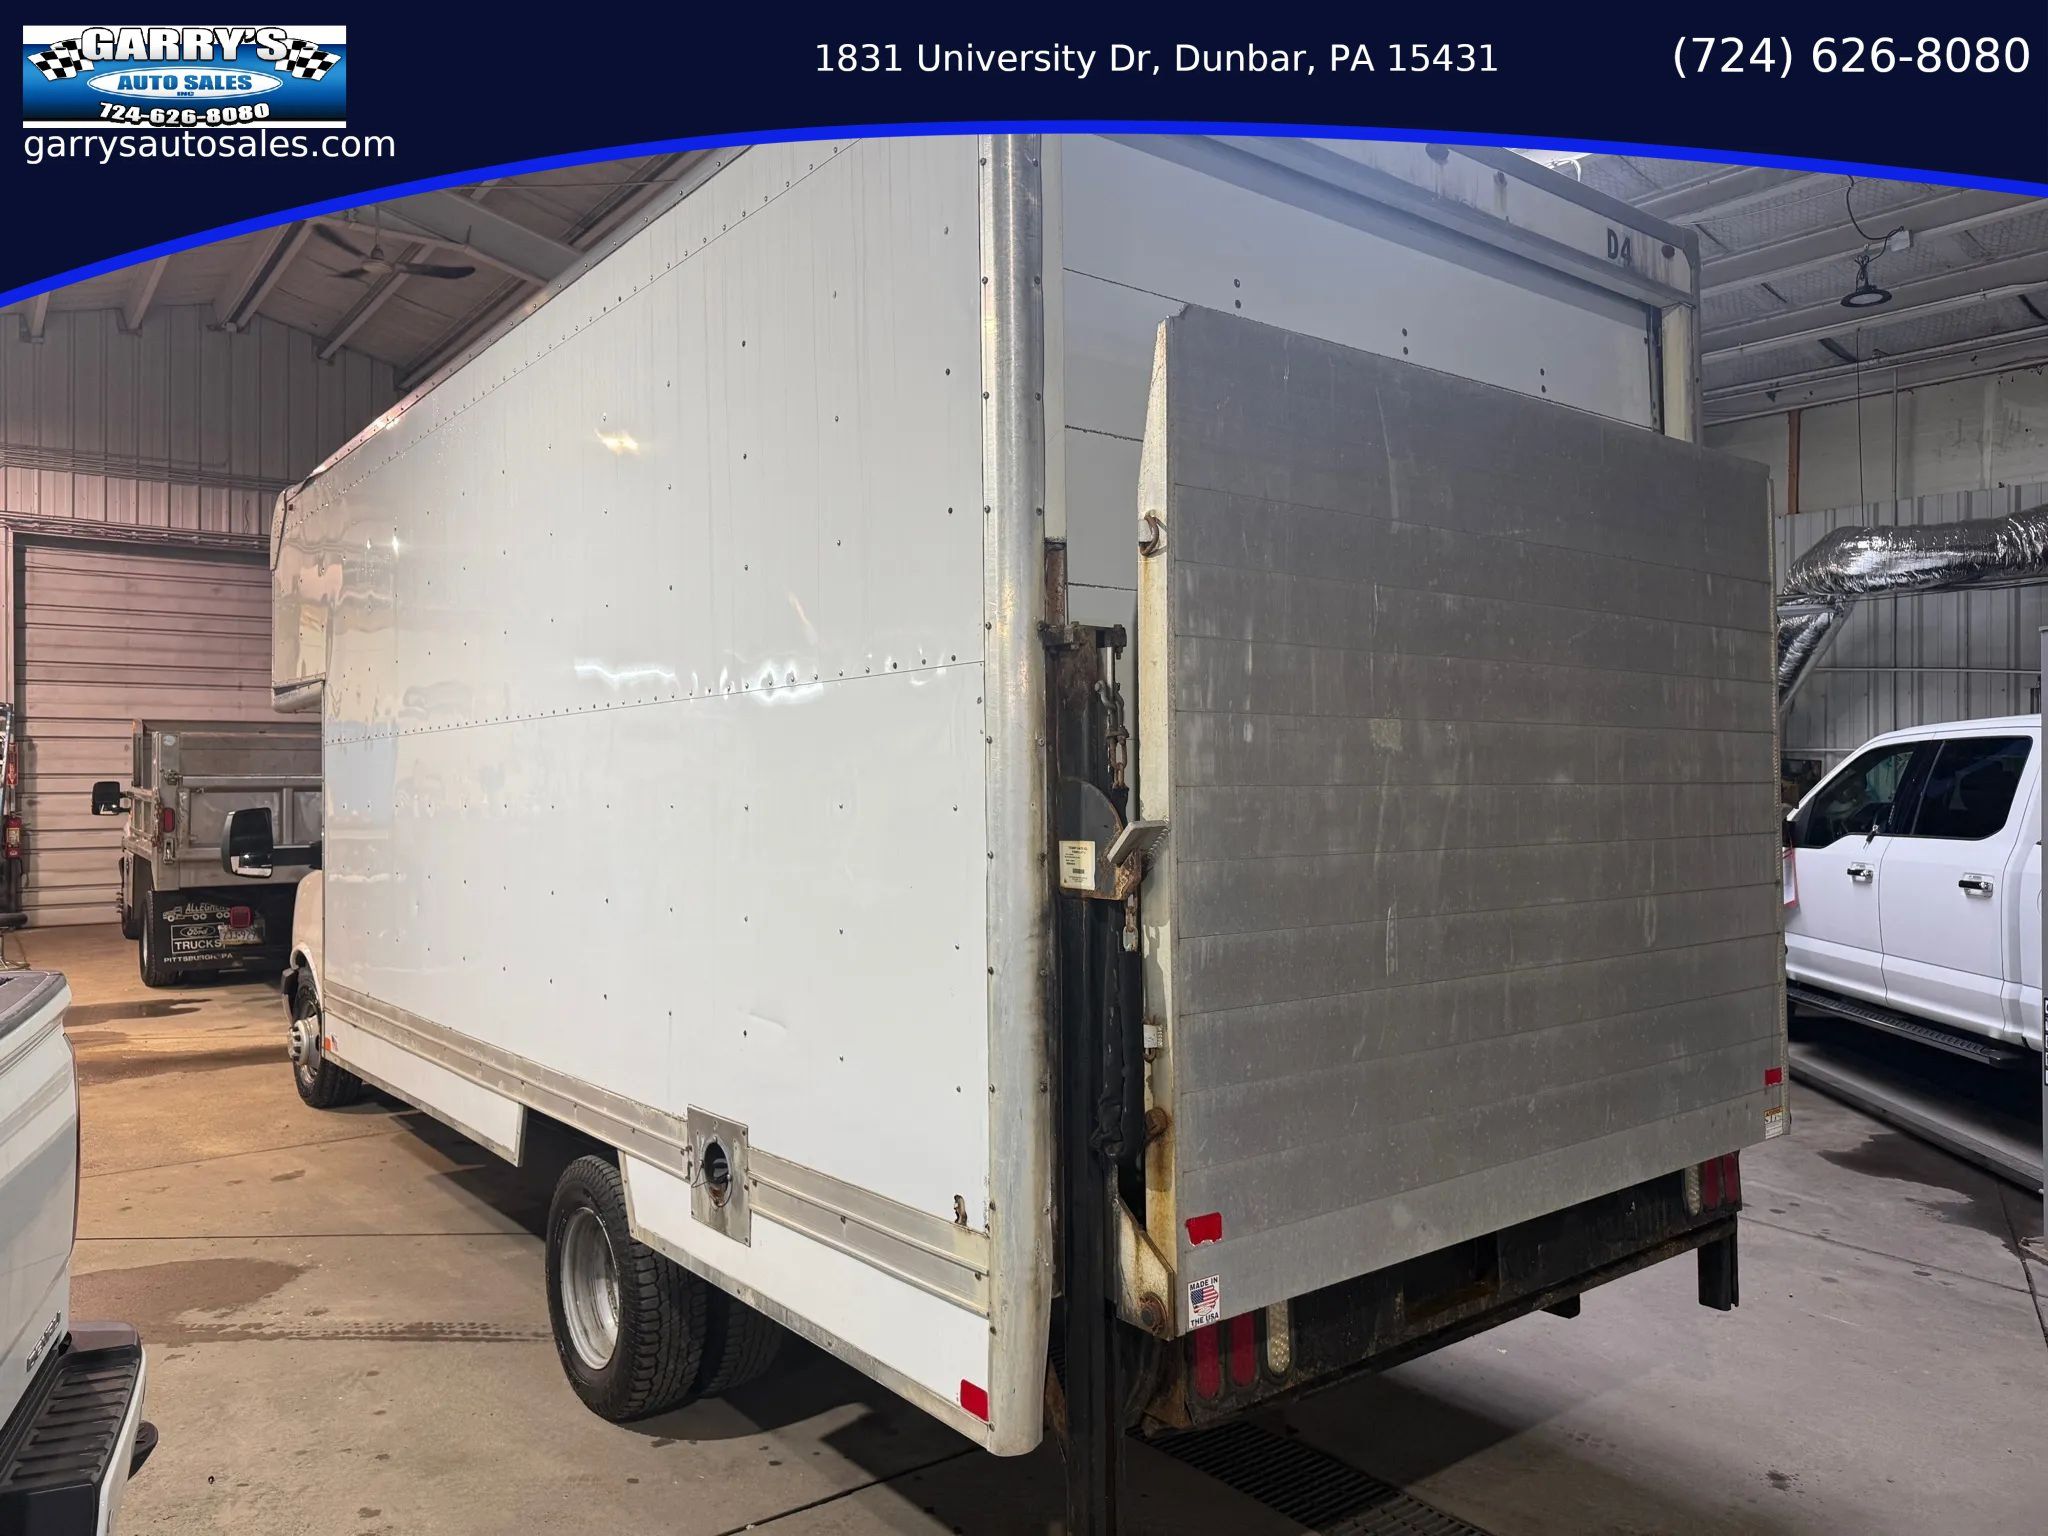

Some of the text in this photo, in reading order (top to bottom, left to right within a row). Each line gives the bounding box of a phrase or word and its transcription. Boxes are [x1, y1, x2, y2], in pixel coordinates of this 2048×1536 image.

[1607, 227, 1632, 267] D4
[174, 939, 222, 951] TRUCKS
[1190, 1276, 1219, 1291] MADE IN
[1190, 1311, 1219, 1327] THE USA
